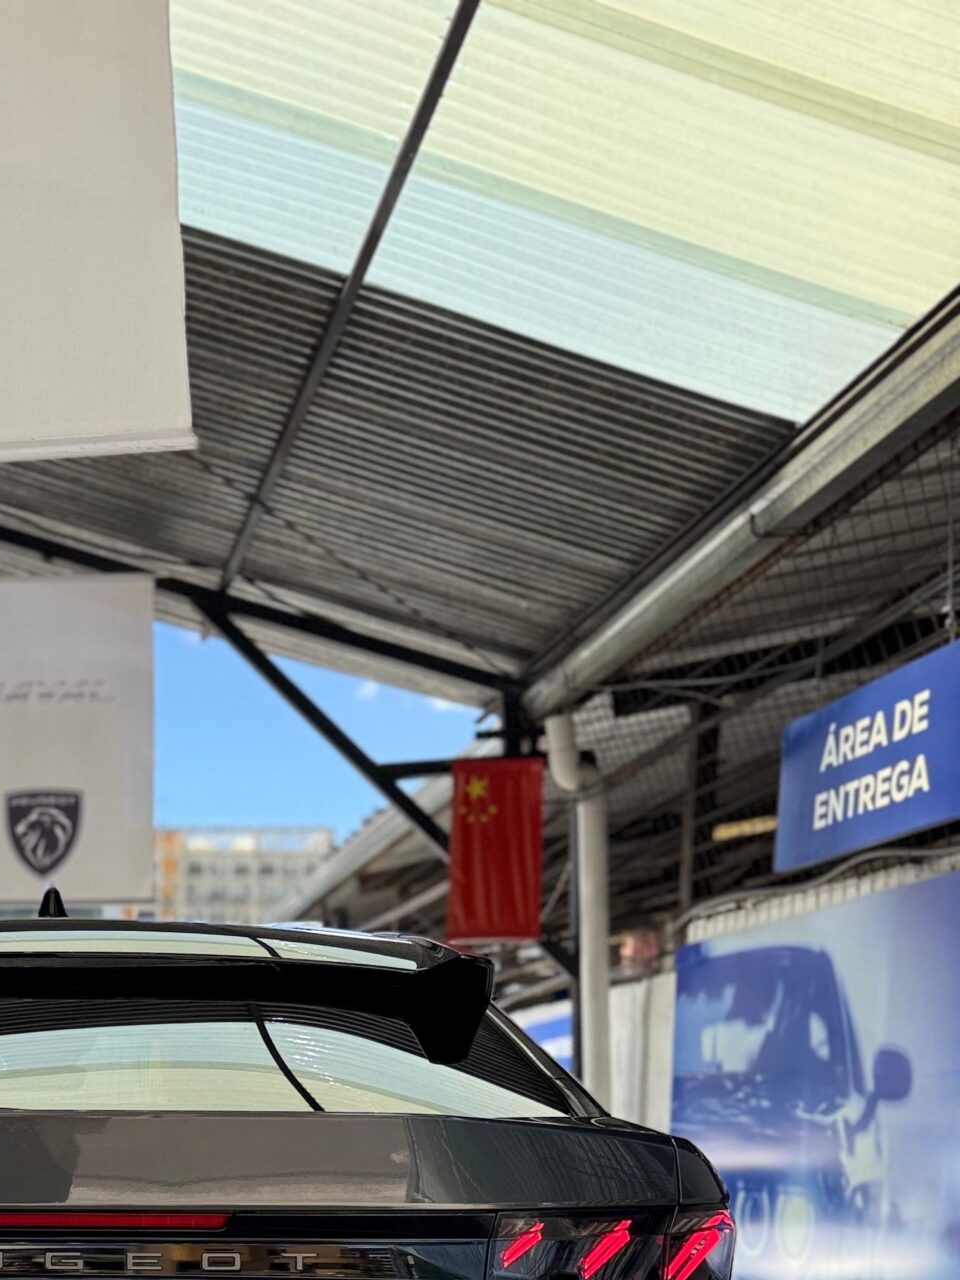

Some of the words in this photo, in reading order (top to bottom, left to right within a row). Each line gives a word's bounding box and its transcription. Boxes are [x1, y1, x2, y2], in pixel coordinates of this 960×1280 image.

[819, 710, 888, 773] ÁREA
[892, 689, 931, 743] DE
[813, 753, 930, 831] ENTREGA
